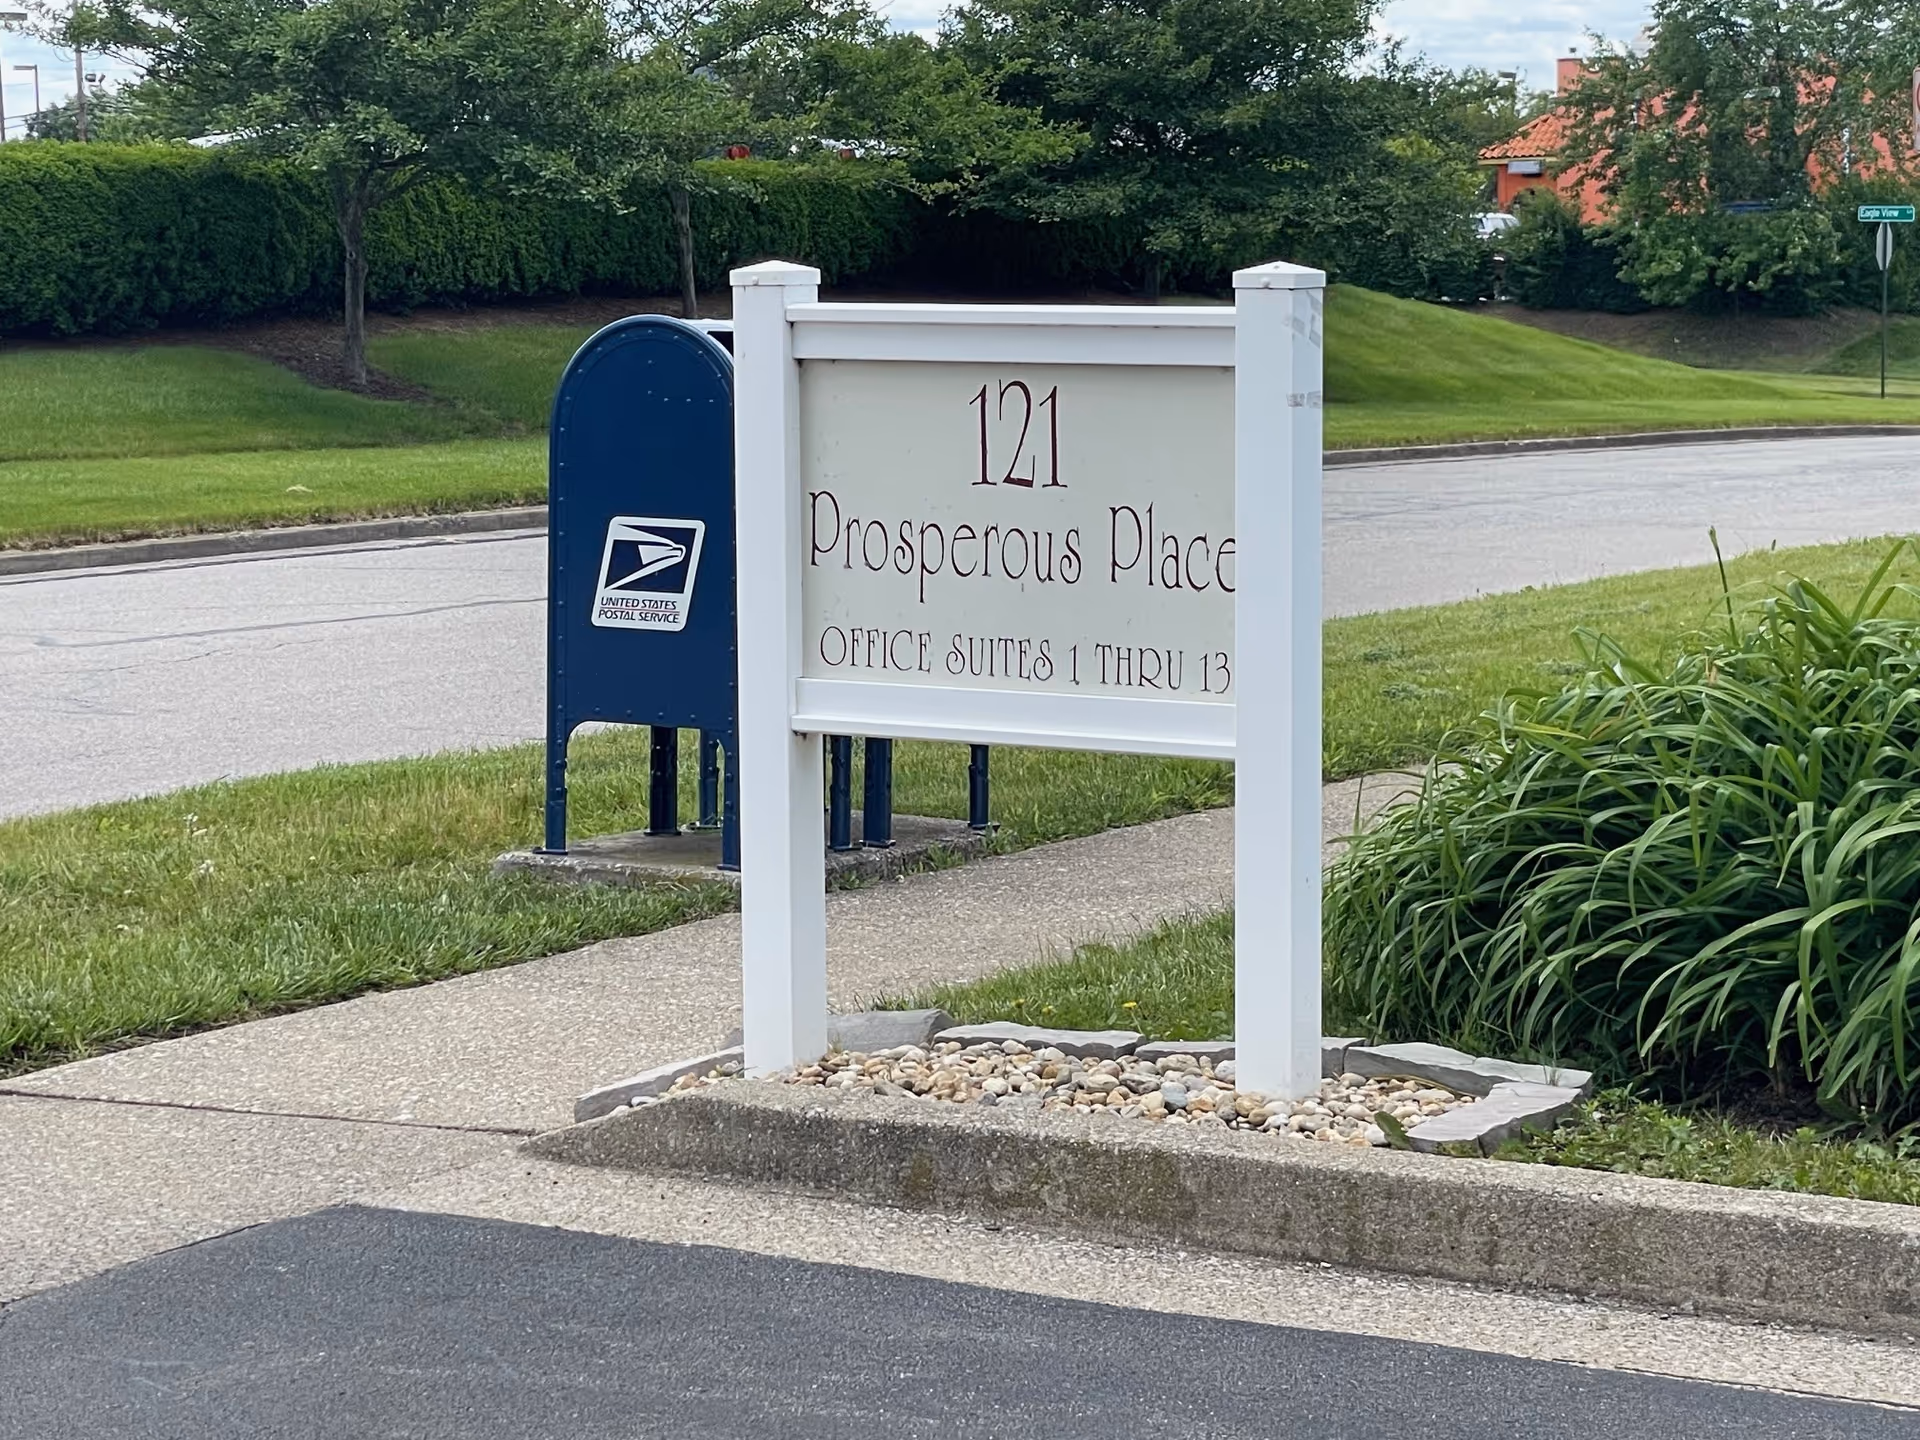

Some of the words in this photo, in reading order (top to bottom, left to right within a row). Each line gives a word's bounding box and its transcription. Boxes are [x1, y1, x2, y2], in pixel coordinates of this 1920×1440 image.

[1881, 209, 1899, 217] View
[969, 379, 1067, 488] 121
[808, 490, 1082, 604] Prosperous
[1109, 502, 1235, 593] Place
[598, 609, 635, 620] POSTAL
[638, 612, 680, 623] SERVICE
[601, 596, 640, 607] UNITED
[641, 599, 677, 610] STATES
[820, 625, 932, 674] OFFICE
[946, 633, 1054, 682] SUITES
[1068, 644, 1081, 686] 1
[1095, 643, 1184, 690] THRU
[1199, 651, 1232, 694] 13
